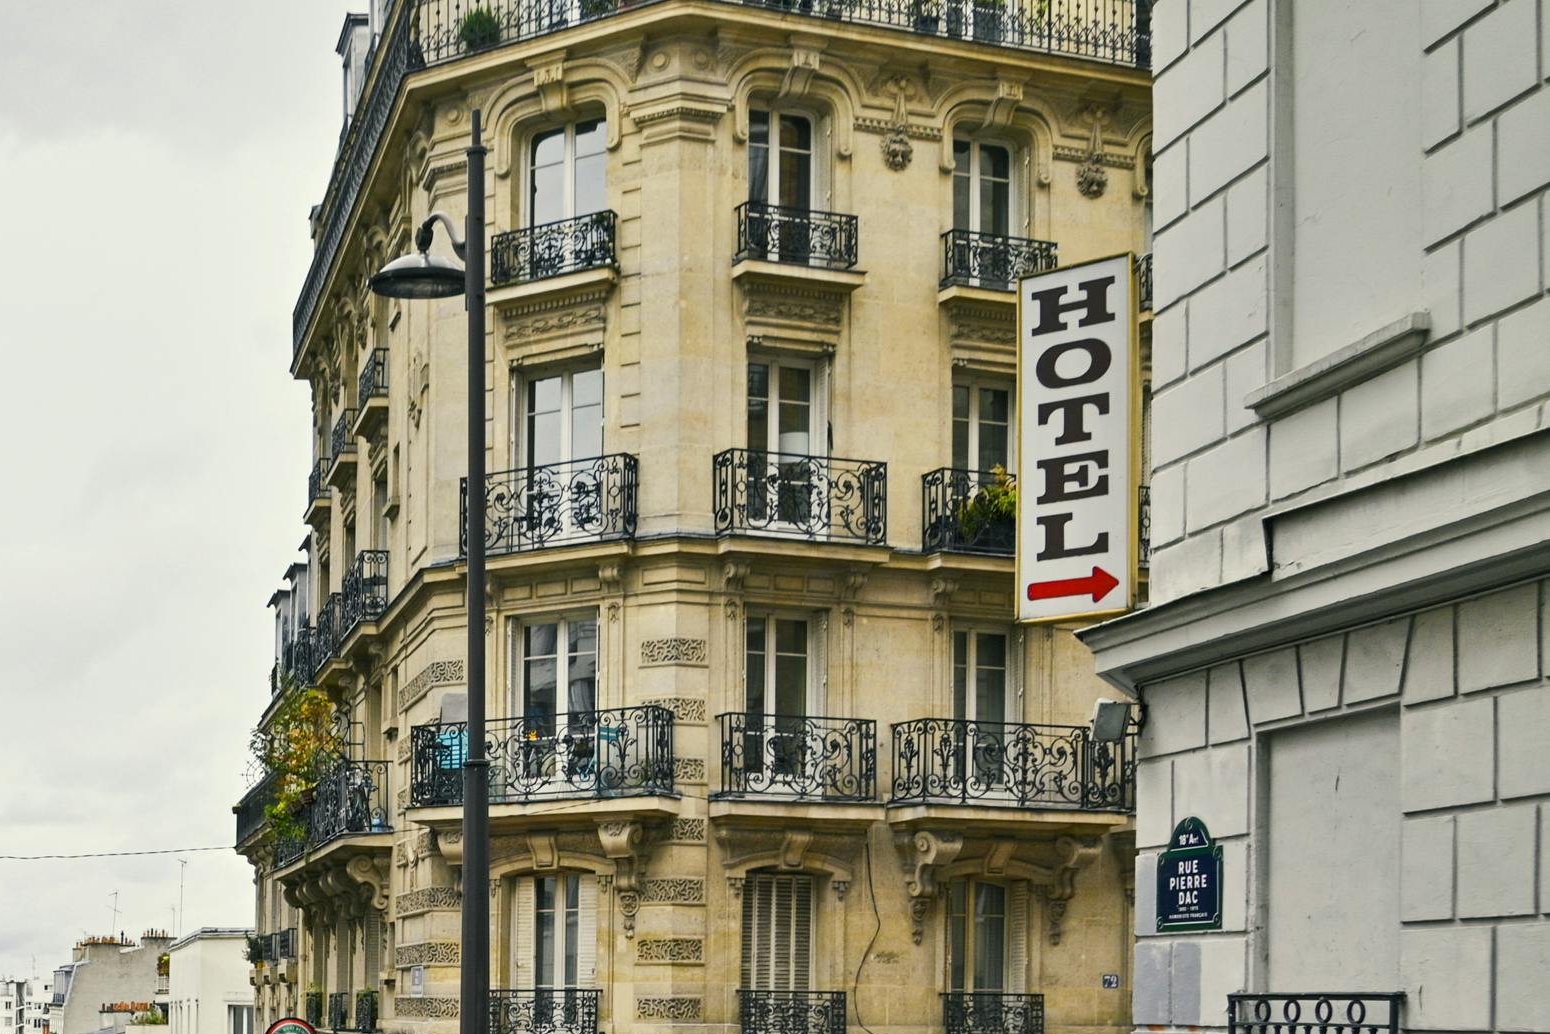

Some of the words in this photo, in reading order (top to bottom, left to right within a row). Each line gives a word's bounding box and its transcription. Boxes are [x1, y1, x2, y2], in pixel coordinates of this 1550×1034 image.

[1031, 275, 1116, 562] HOTEL
[1178, 860, 1198, 874] RUE
[1169, 874, 1207, 890] PIERRE
[1178, 890, 1198, 905] DAC
[1103, 975, 1117, 988] 72
